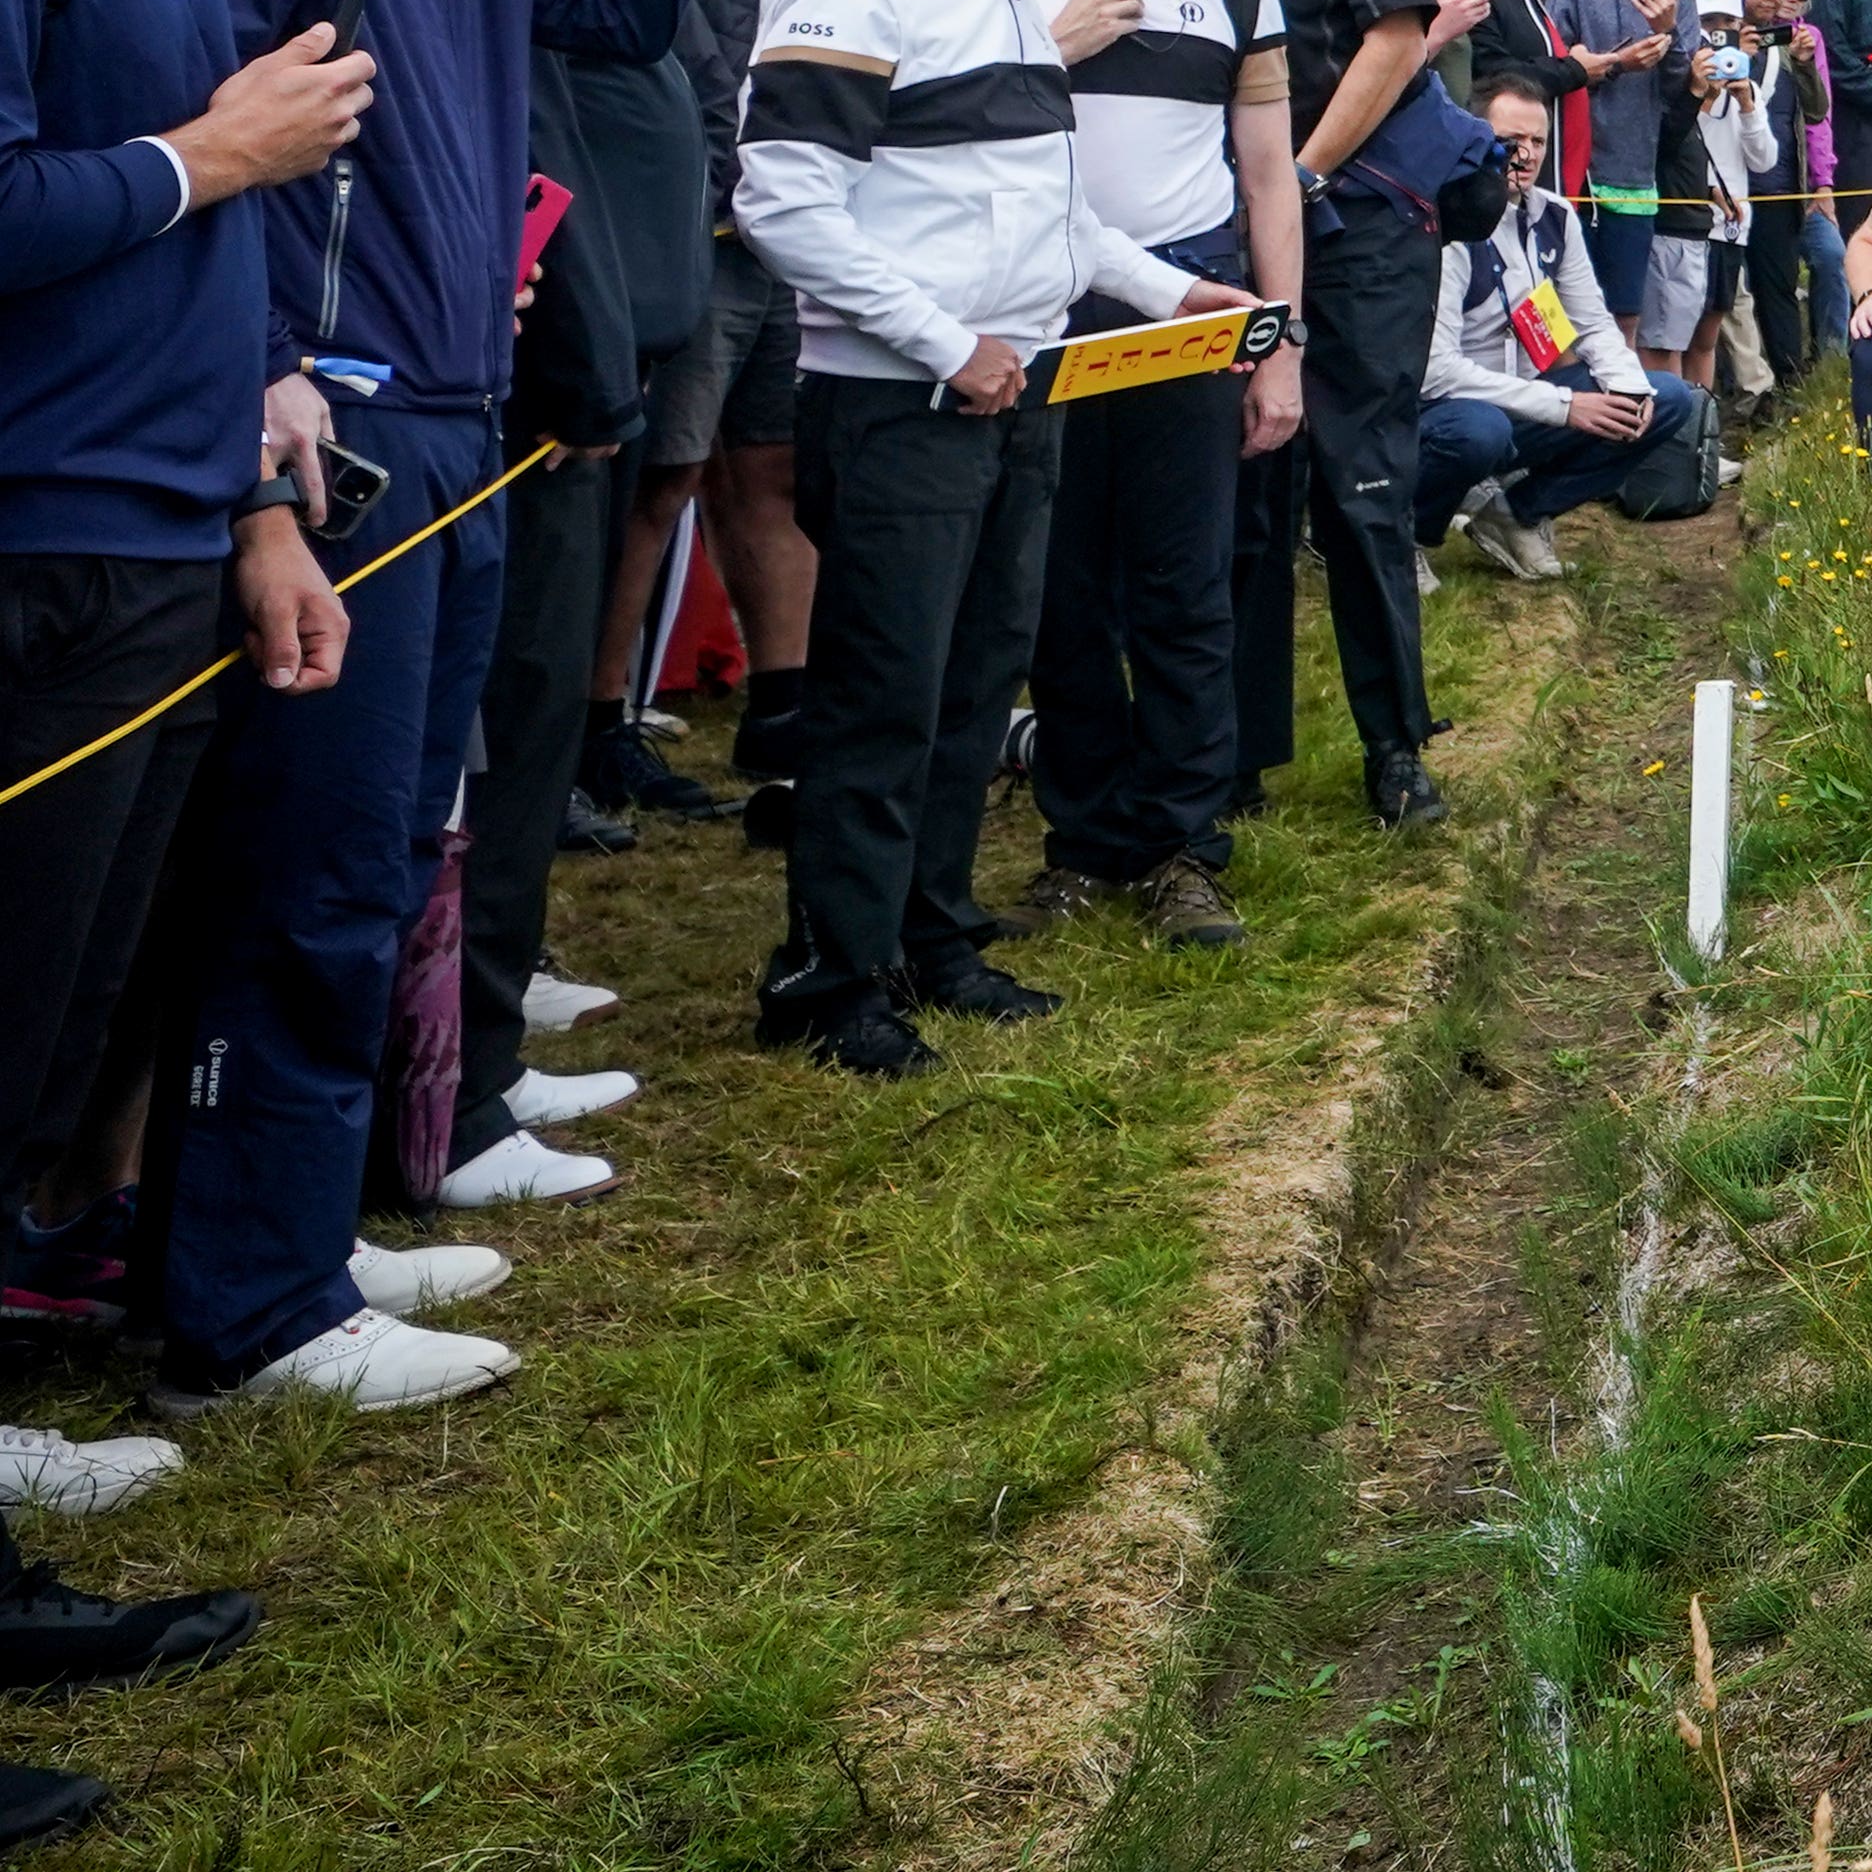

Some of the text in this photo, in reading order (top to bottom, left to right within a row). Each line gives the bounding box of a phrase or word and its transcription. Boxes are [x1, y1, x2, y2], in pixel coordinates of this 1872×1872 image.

[788, 22, 835, 37] BOSS
[1087, 328, 1234, 377] QUIET
[206, 1056, 222, 1107] sunice
